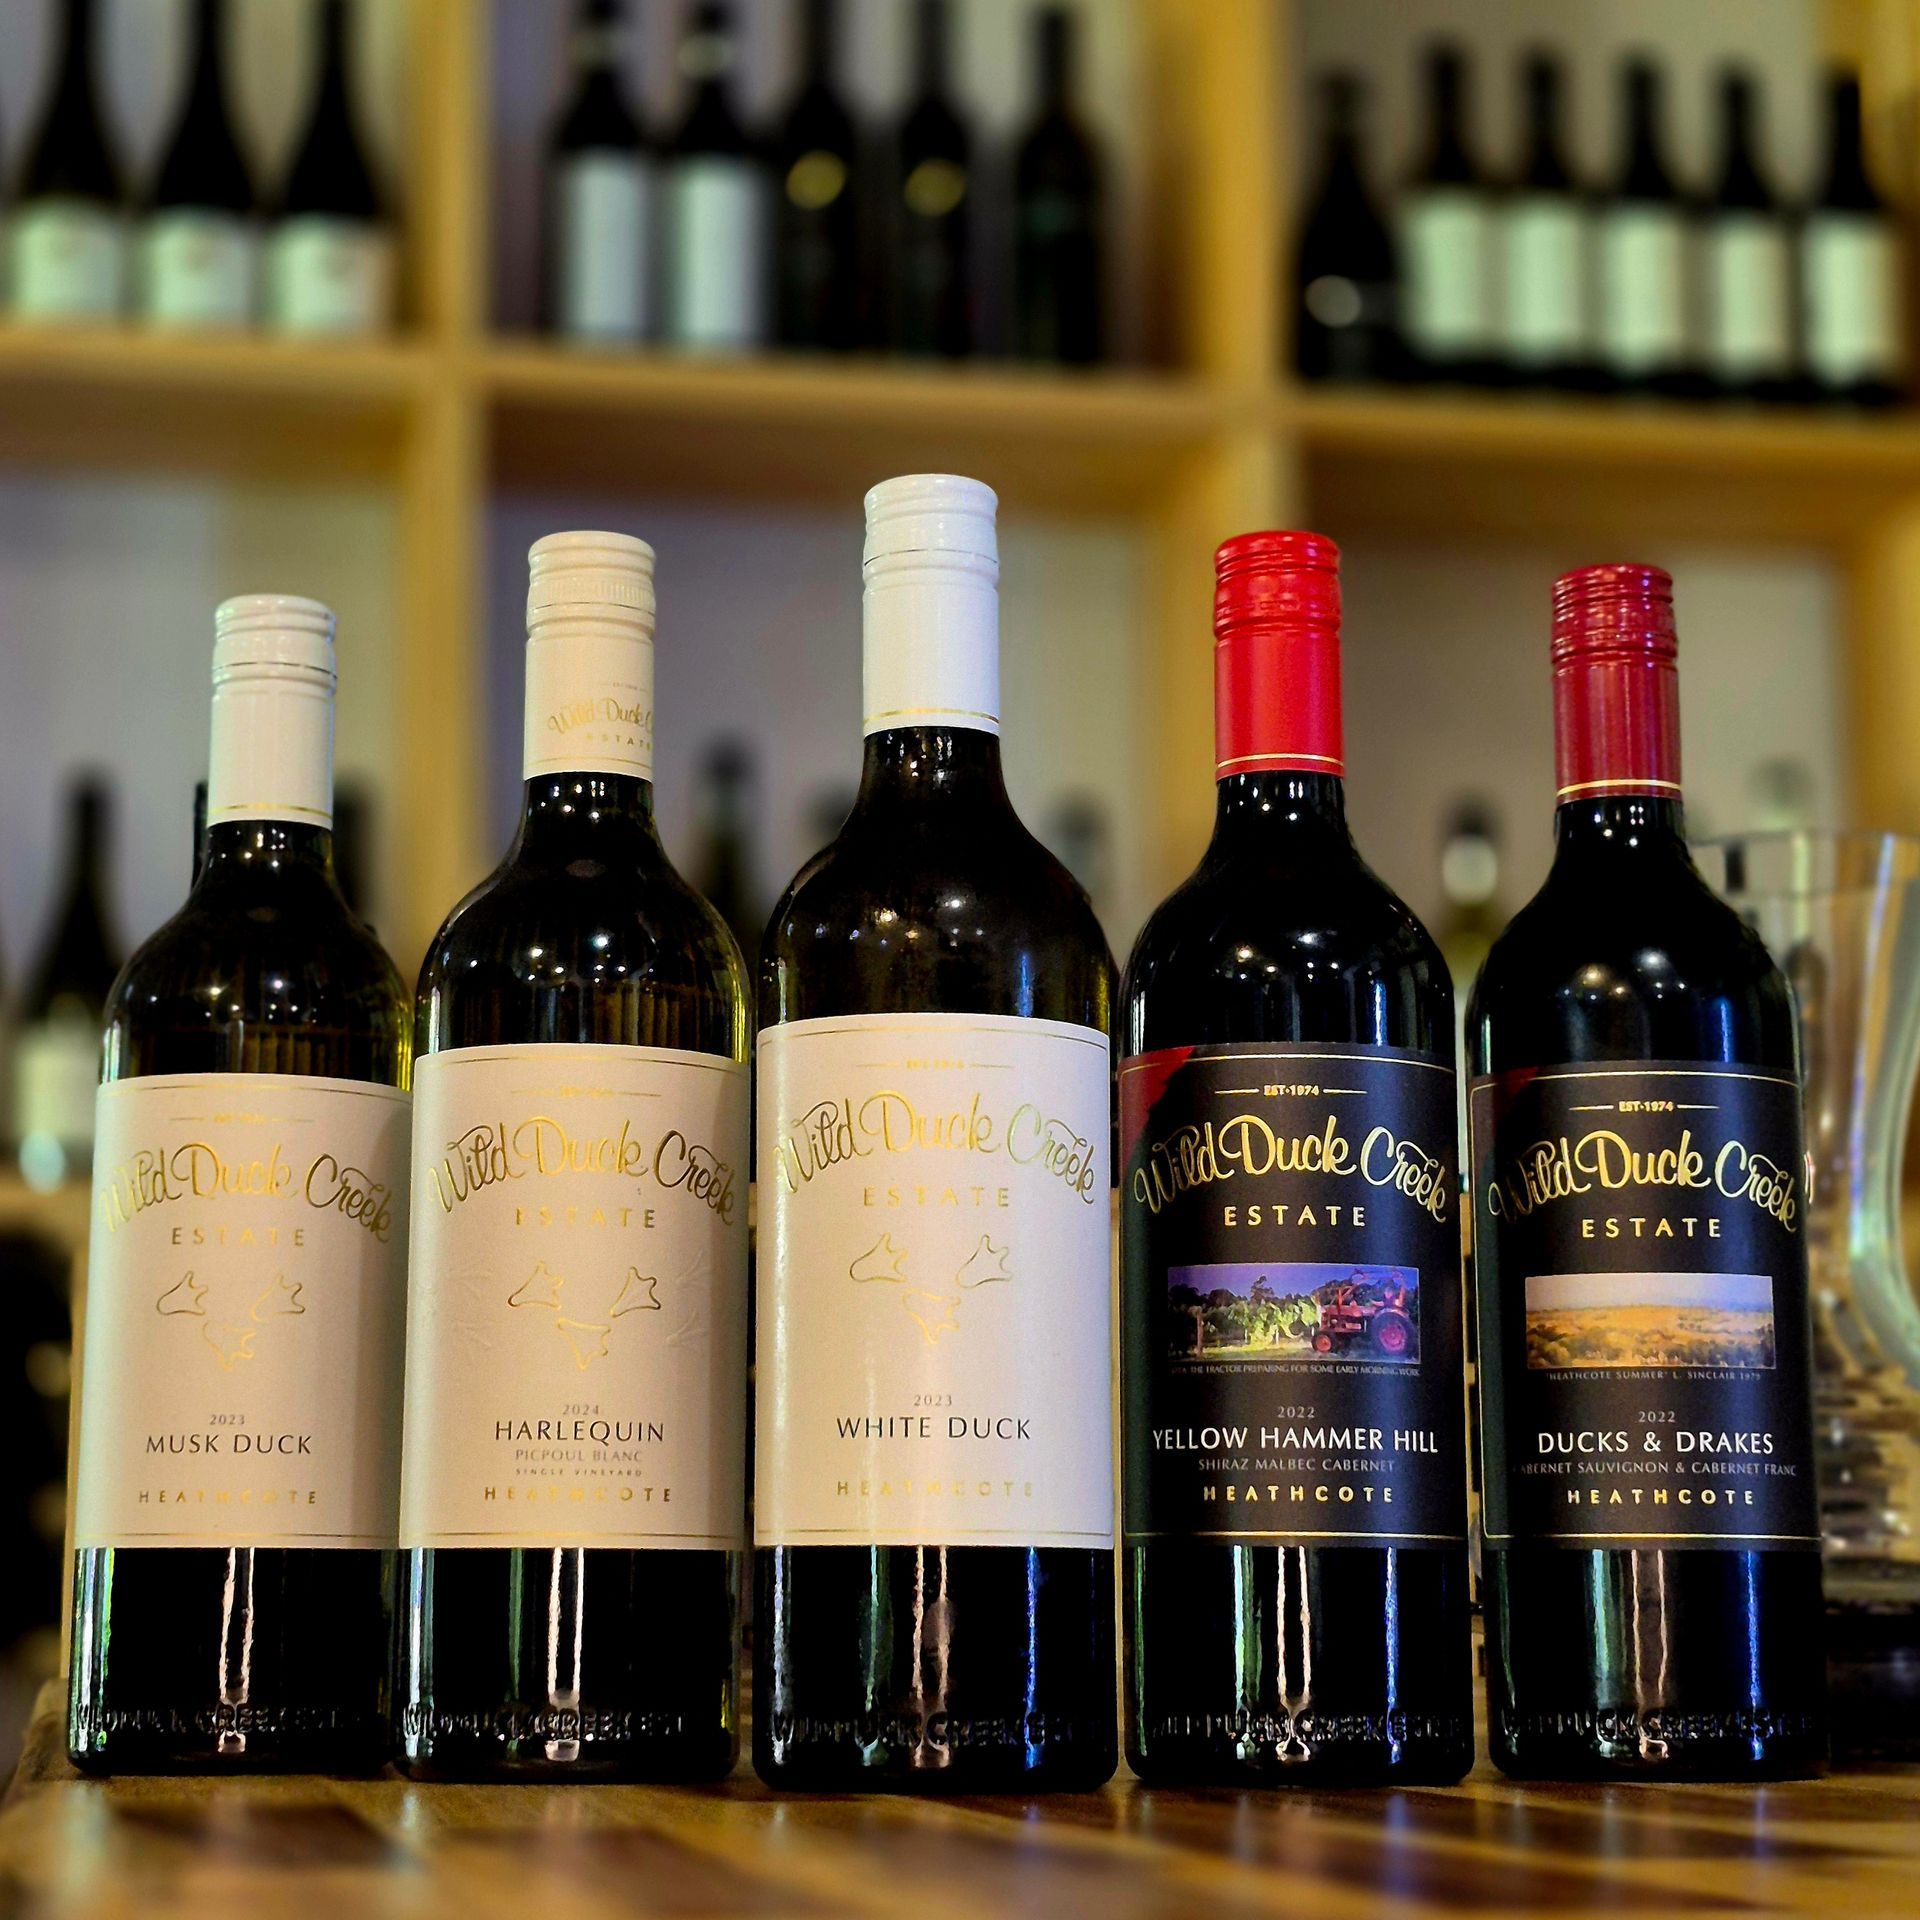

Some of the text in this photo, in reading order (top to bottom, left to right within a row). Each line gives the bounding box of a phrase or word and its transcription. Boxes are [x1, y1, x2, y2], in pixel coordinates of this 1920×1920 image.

[597, 697, 645, 728] Duck
[773, 1090, 1094, 1205] Wild Duck Creek
[431, 1115, 734, 1226] Wild Duck Creek
[1134, 1115, 1447, 1223] Wild Duck Creek
[1488, 1129, 1797, 1233] Wild Duck Creek
[102, 1142, 390, 1243] Wild Duck Creek
[864, 1187, 1009, 1207] ESTATE
[516, 1208, 656, 1229] ESTATE
[1224, 1205, 1366, 1227] ESTATE
[171, 1227, 305, 1246] ESTATE
[1582, 1218, 1721, 1238] ESTATE
[1687, 1371, 1736, 1381] SINCLAIR
[562, 1404, 600, 1416] 2024
[914, 1394, 953, 1407] 2023
[210, 1413, 246, 1426] 2023
[1277, 1406, 1316, 1419] 2022
[1638, 1410, 1677, 1423] 2022
[495, 1420, 665, 1446] HARLEQUIN
[837, 1416, 1031, 1440] WHITE DUCK
[146, 1434, 312, 1455] MUSK DUCK
[1152, 1427, 1439, 1453] YELLOW HAMMER HILL
[1538, 1431, 1774, 1455] DUCKS & DRAKES
[515, 1449, 642, 1462] PICPOUL BLANC
[1198, 1458, 1395, 1473] SHIRAZ MALBEC CABERNET
[1513, 1461, 1797, 1476] ABERNET SAUVIGNON & CABERNET FRANC
[139, 1491, 317, 1504] HEATHCOTE
[485, 1487, 671, 1502] HEATHCOTE
[837, 1481, 1034, 1497] HEATHCOTE
[1204, 1486, 1393, 1503] HEATHCOTE
[1568, 1488, 1754, 1505] HEATHCOTE
